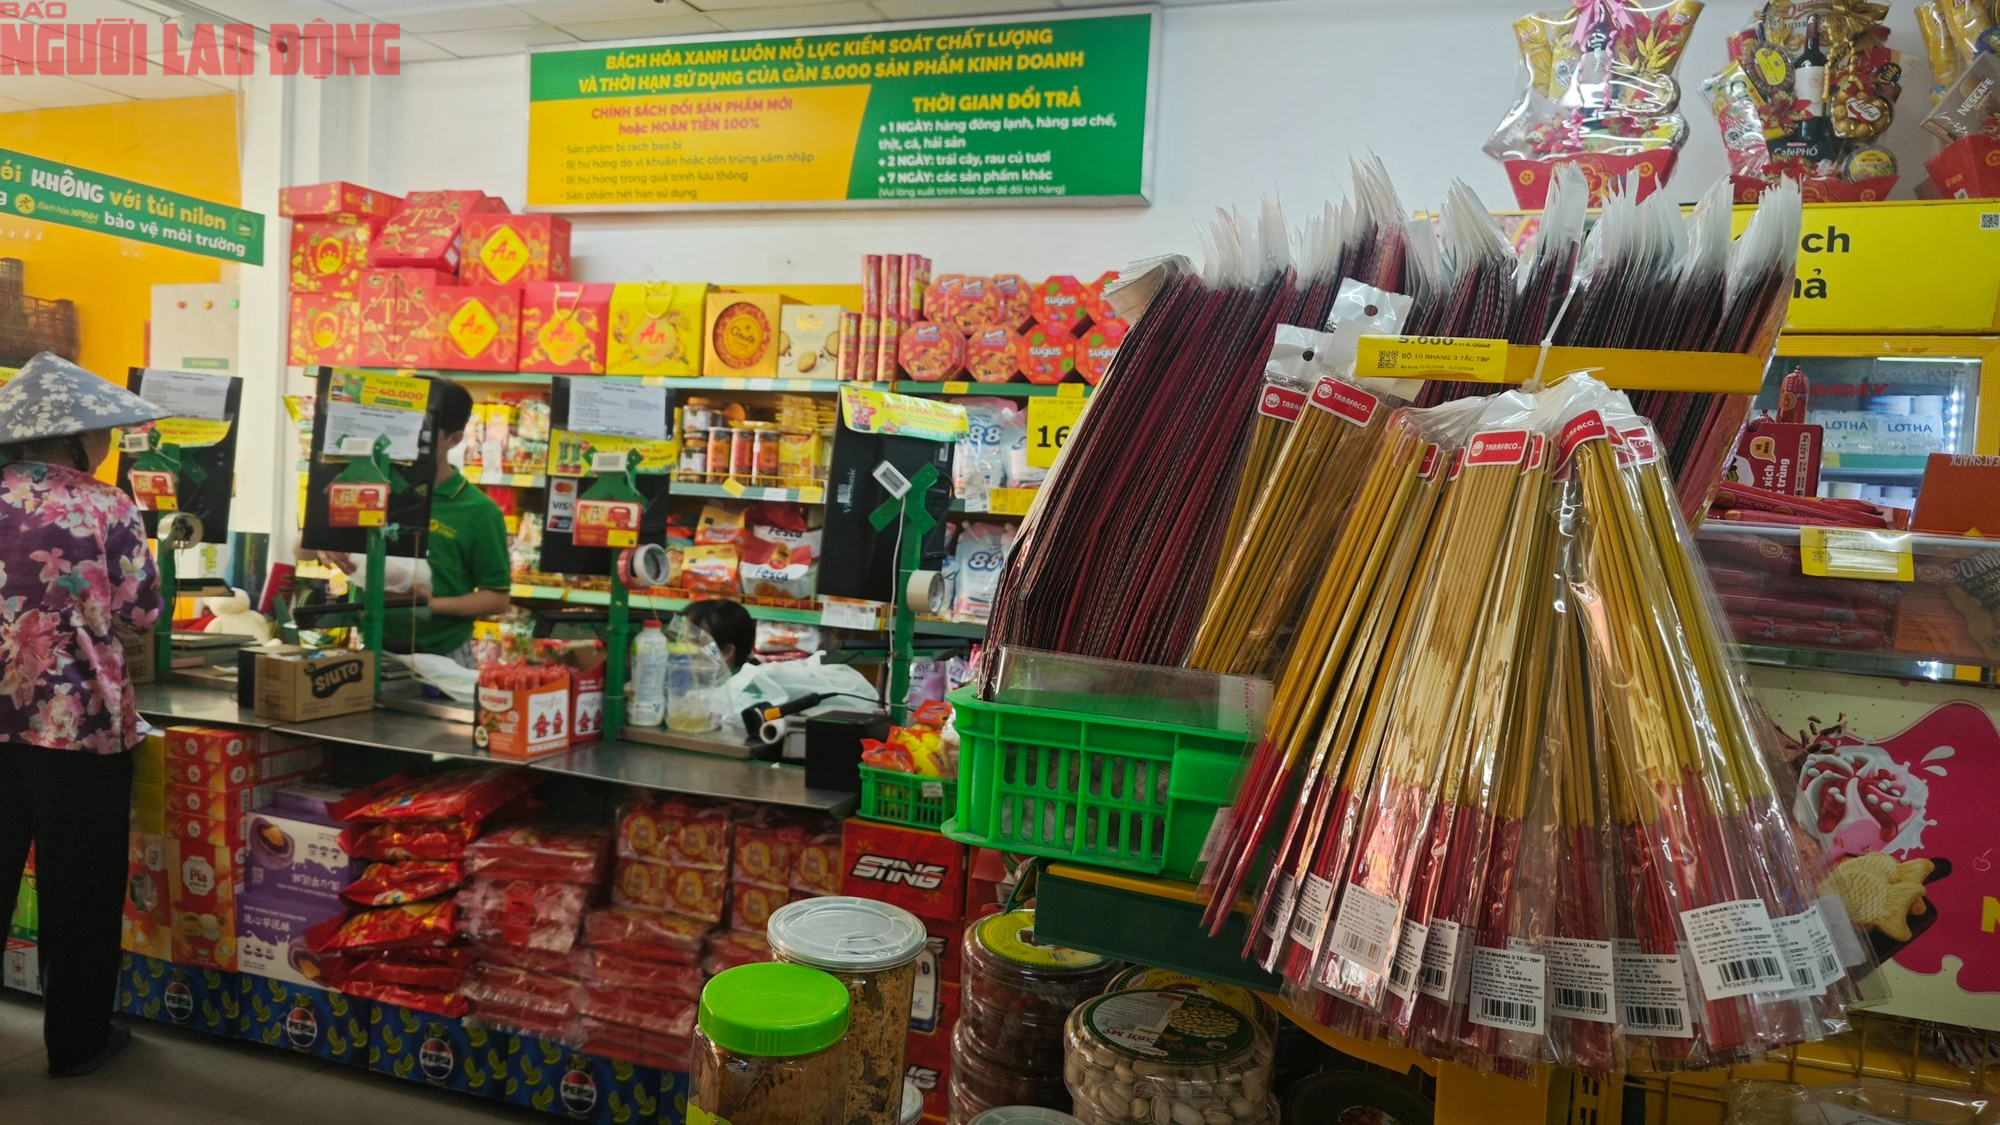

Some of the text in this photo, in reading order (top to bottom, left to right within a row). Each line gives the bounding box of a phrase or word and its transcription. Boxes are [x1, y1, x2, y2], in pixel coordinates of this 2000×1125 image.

[606, 27, 1053, 70] BÁCH HÓA XANH LUÔN NỖ LỰC KIỂM SOÁT CHẤT LƯỢNG
[578, 51, 1085, 94] VÀ THỜI HẠN SỬ DỤNG CỦA GẦN 5.000 SẢN PHẨM KINH DOANH
[912, 85, 1082, 113] THỜI GIAN ĐỔI TRẢ
[591, 104, 630, 120] CHÍNH
[634, 101, 667, 118] SÁCH
[696, 98, 722, 115] SẢN
[726, 95, 763, 113] PHẨM
[767, 95, 793, 112] MỚI
[651, 118, 687, 134] HOÀN
[723, 116, 760, 131] 100%
[889, 121, 895, 133] 1
[896, 117, 934, 133] NGÀY:
[935, 118, 967, 133] hàng
[968, 117, 1001, 133] đông
[1003, 115, 1034, 132] lạnh,
[1036, 115, 1070, 131] hàng
[887, 155, 896, 168] 2
[897, 152, 935, 167] NGÀY:
[984, 153, 1006, 165] rau
[887, 172, 896, 184] 7
[897, 170, 935, 184] NGÀY:
[936, 169, 958, 183] các
[983, 167, 1020, 184] phẩm
[1021, 168, 1053, 182] khác
[30, 168, 104, 204] KHÔNG
[109, 188, 141, 212] với
[147, 195, 175, 219] túi
[180, 206, 227, 231] nilon
[104, 211, 246, 257] bảo vệ môi trường
[1044, 296, 1076, 308] sugus
[1029, 347, 1062, 359] sugus
[1402, 352, 1412, 360] BỘ
[1425, 353, 1451, 361] NHANG
[1809, 383, 1890, 397] ANAKY
[1282, 400, 1304, 411] TABAF
[1333, 393, 1367, 412] TABAFACO
[1825, 420, 1868, 431] LOTHA
[1887, 423, 1933, 433] LOTHA
[969, 424, 1002, 446] 88
[1485, 443, 1518, 451] TABAFACO
[755, 566, 789, 581] Fesca
[315, 661, 359, 692] SIUTO
[1709, 905, 1734, 914] NHANG
[1491, 952, 1511, 960] NHANG
[288, 1022, 315, 1034] PEPSI
[422, 1051, 451, 1065] PEPSI
[562, 1083, 594, 1098] PEPSI
